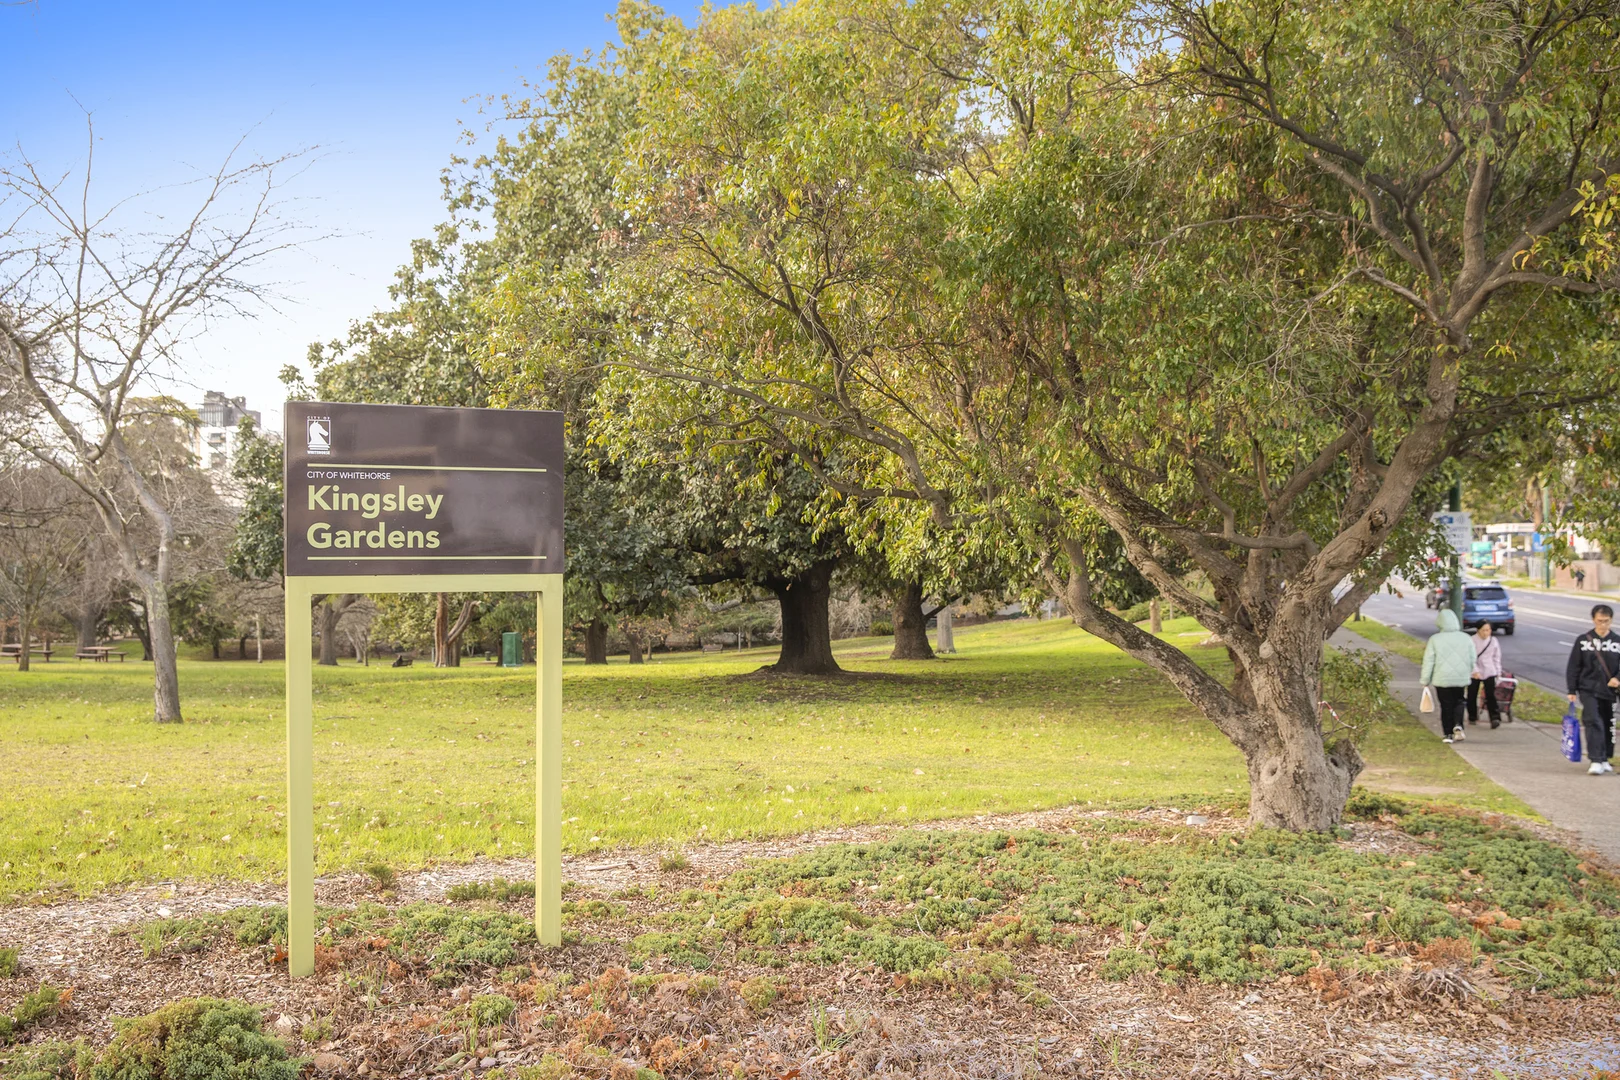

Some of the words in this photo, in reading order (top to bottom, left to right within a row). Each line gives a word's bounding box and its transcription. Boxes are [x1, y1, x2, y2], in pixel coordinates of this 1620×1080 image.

[306, 471, 325, 479] CITY
[326, 471, 338, 479] OF
[339, 472, 391, 480] WHITEHORSE
[308, 485, 444, 519] Kingsley
[306, 521, 441, 549] Gardens
